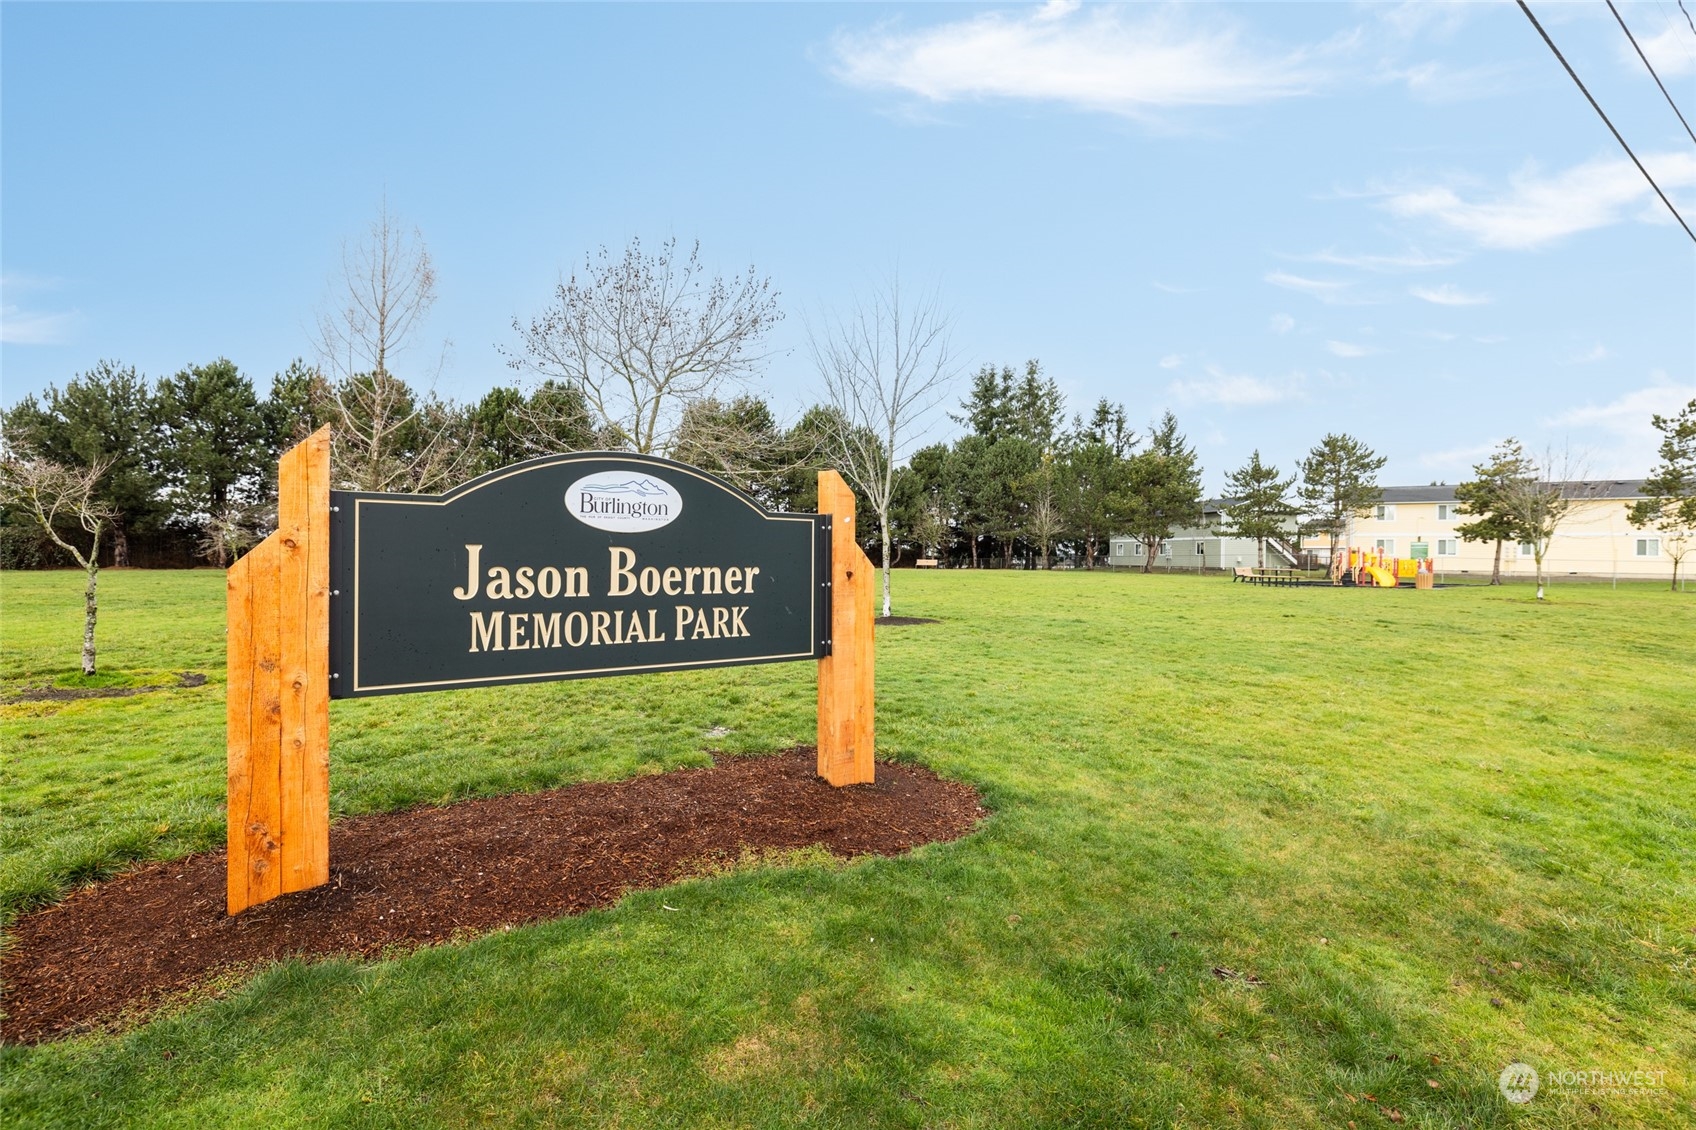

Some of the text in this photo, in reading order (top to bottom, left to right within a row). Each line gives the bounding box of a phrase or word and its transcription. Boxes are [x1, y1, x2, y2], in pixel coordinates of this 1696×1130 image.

[580, 492, 668, 518] Burlington
[453, 544, 760, 600] Jason Boerner
[469, 605, 750, 652] MEMORIAL PARK
